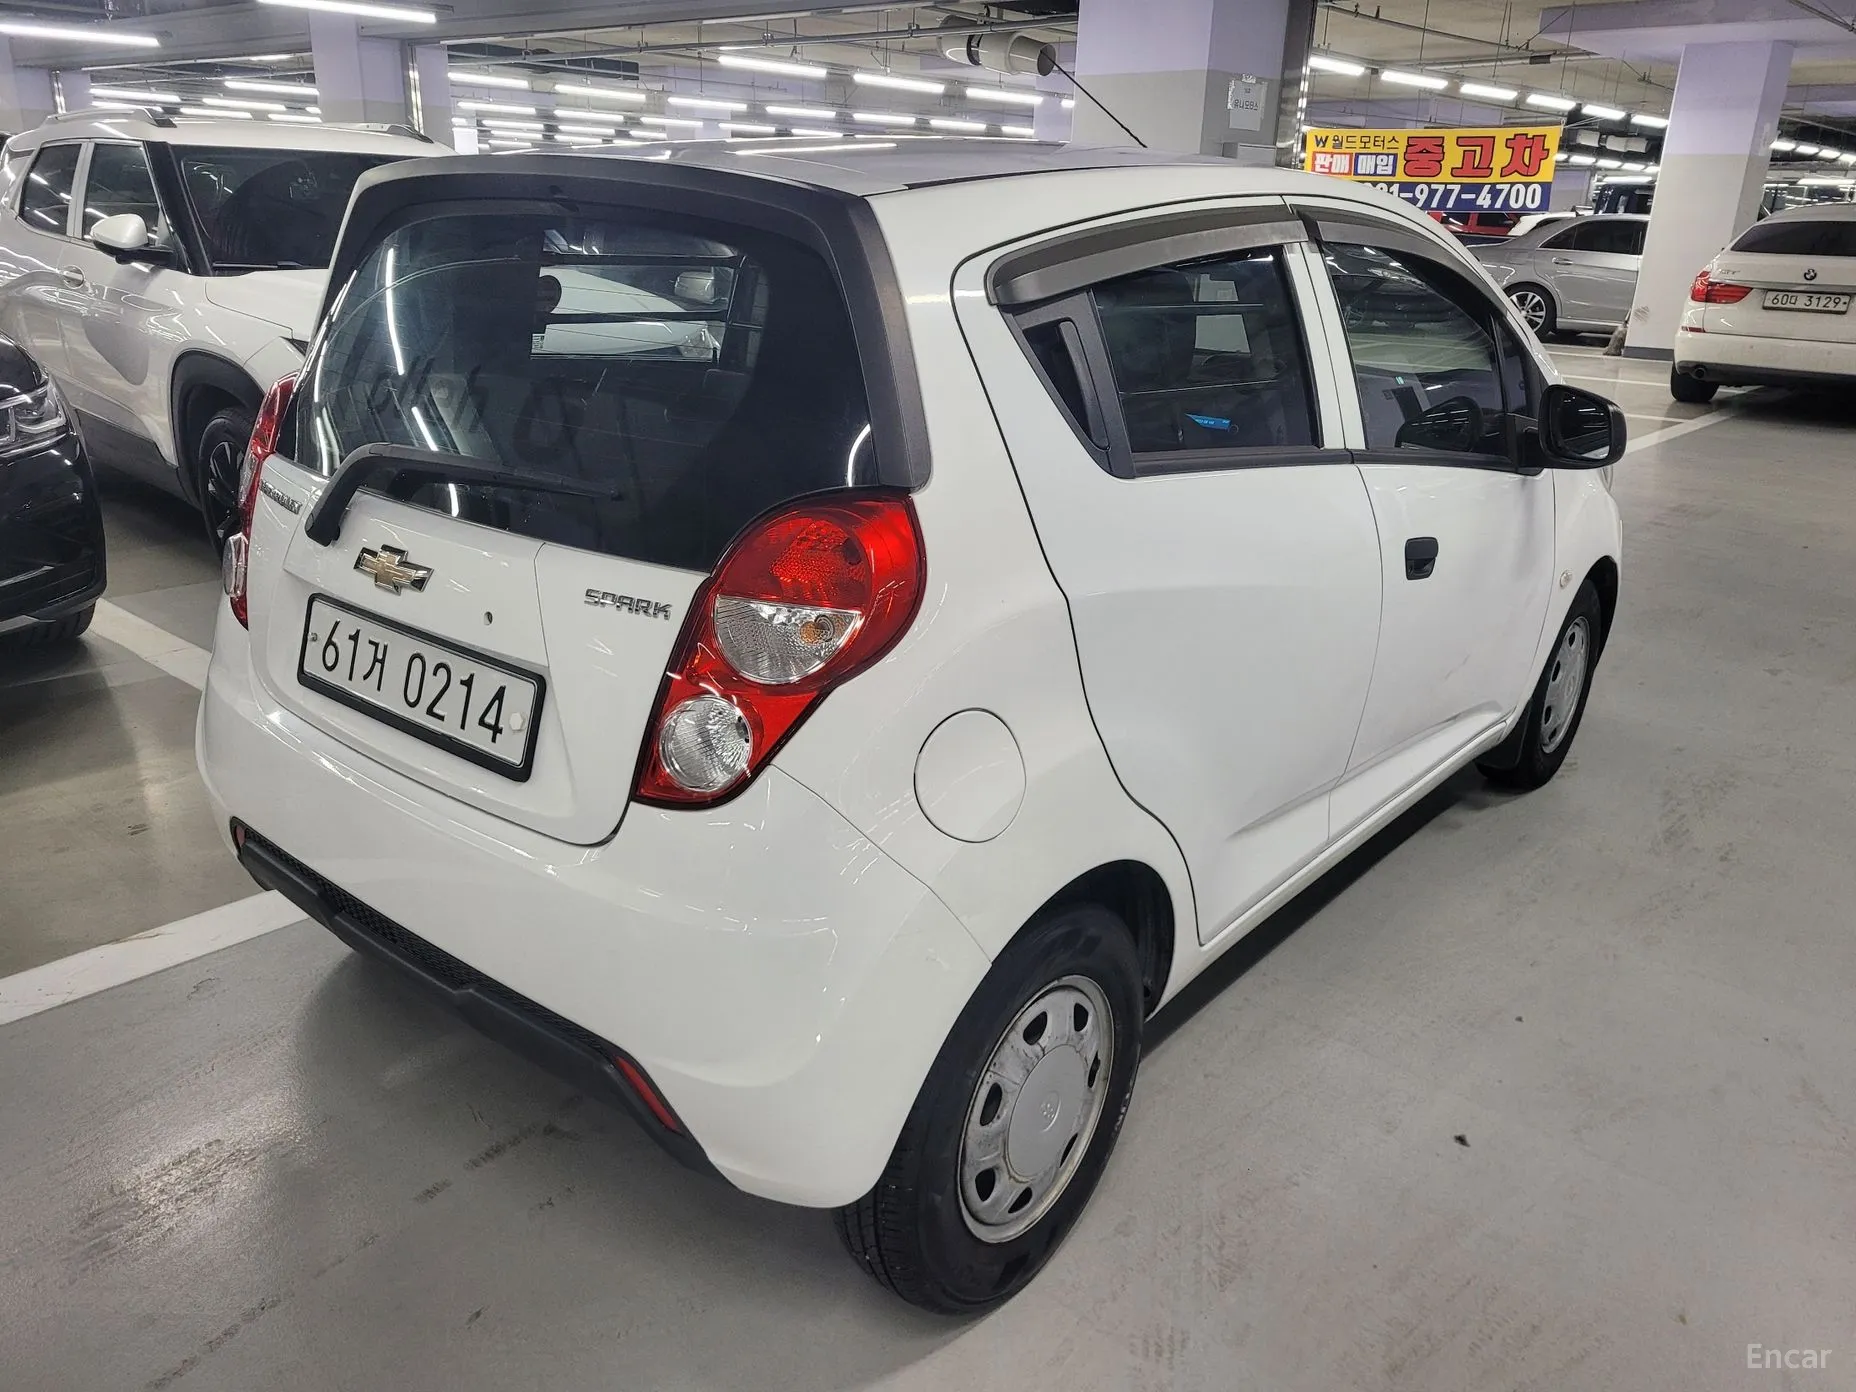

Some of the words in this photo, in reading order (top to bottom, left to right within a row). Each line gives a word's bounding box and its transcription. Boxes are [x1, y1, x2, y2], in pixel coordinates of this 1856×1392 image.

[1332, 134, 1400, 150] 월드모터스
[1403, 133, 1550, 178] 중고차
[1314, 152, 1351, 174] 판매
[1357, 154, 1395, 175] 매입
[1363, 182, 1542, 209] 1-977-4700
[1803, 295, 1842, 309] 3129
[583, 588, 673, 621] SPARK
[321, 618, 389, 692] 61거
[403, 651, 507, 744] 0214
